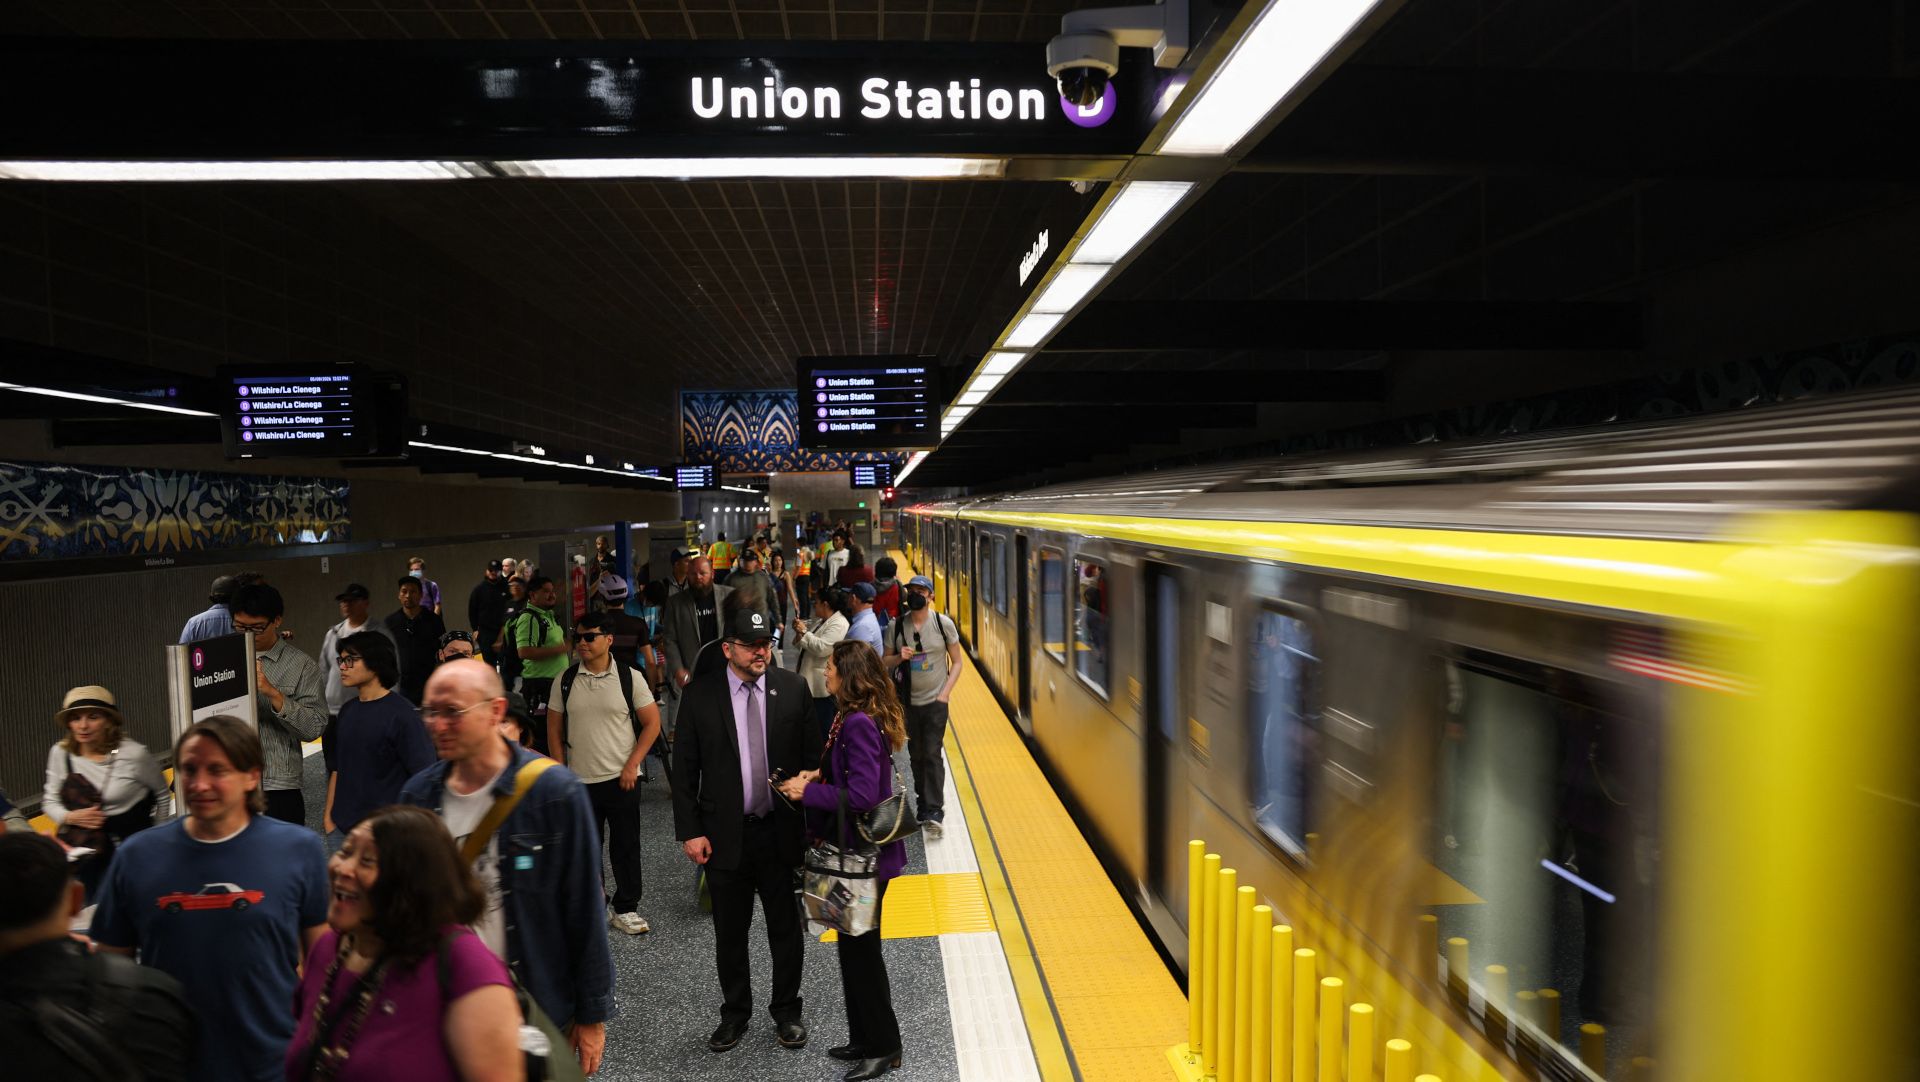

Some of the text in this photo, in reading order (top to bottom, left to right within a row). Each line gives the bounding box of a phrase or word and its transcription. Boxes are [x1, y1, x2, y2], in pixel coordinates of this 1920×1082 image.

[691, 76, 841, 119] Union
[860, 77, 1045, 120] Station
[828, 378, 849, 387] Union
[849, 377, 875, 386] Station
[250, 385, 292, 395] Wilshire/La
[292, 385, 321, 395] Cienega
[828, 393, 849, 402] Union
[849, 392, 875, 401] Station
[252, 401, 293, 410] Wilshire/La
[293, 400, 322, 410] Cienega
[829, 408, 850, 416] Union
[850, 407, 876, 416] Station
[253, 416, 294, 425] Wilshire/La
[294, 415, 324, 425] Cienega
[829, 422, 850, 431] Union
[850, 422, 876, 431] Station
[255, 431, 296, 440] Wilshire/La
[296, 430, 325, 440] Cienega
[193, 668, 236, 688] Union Station
